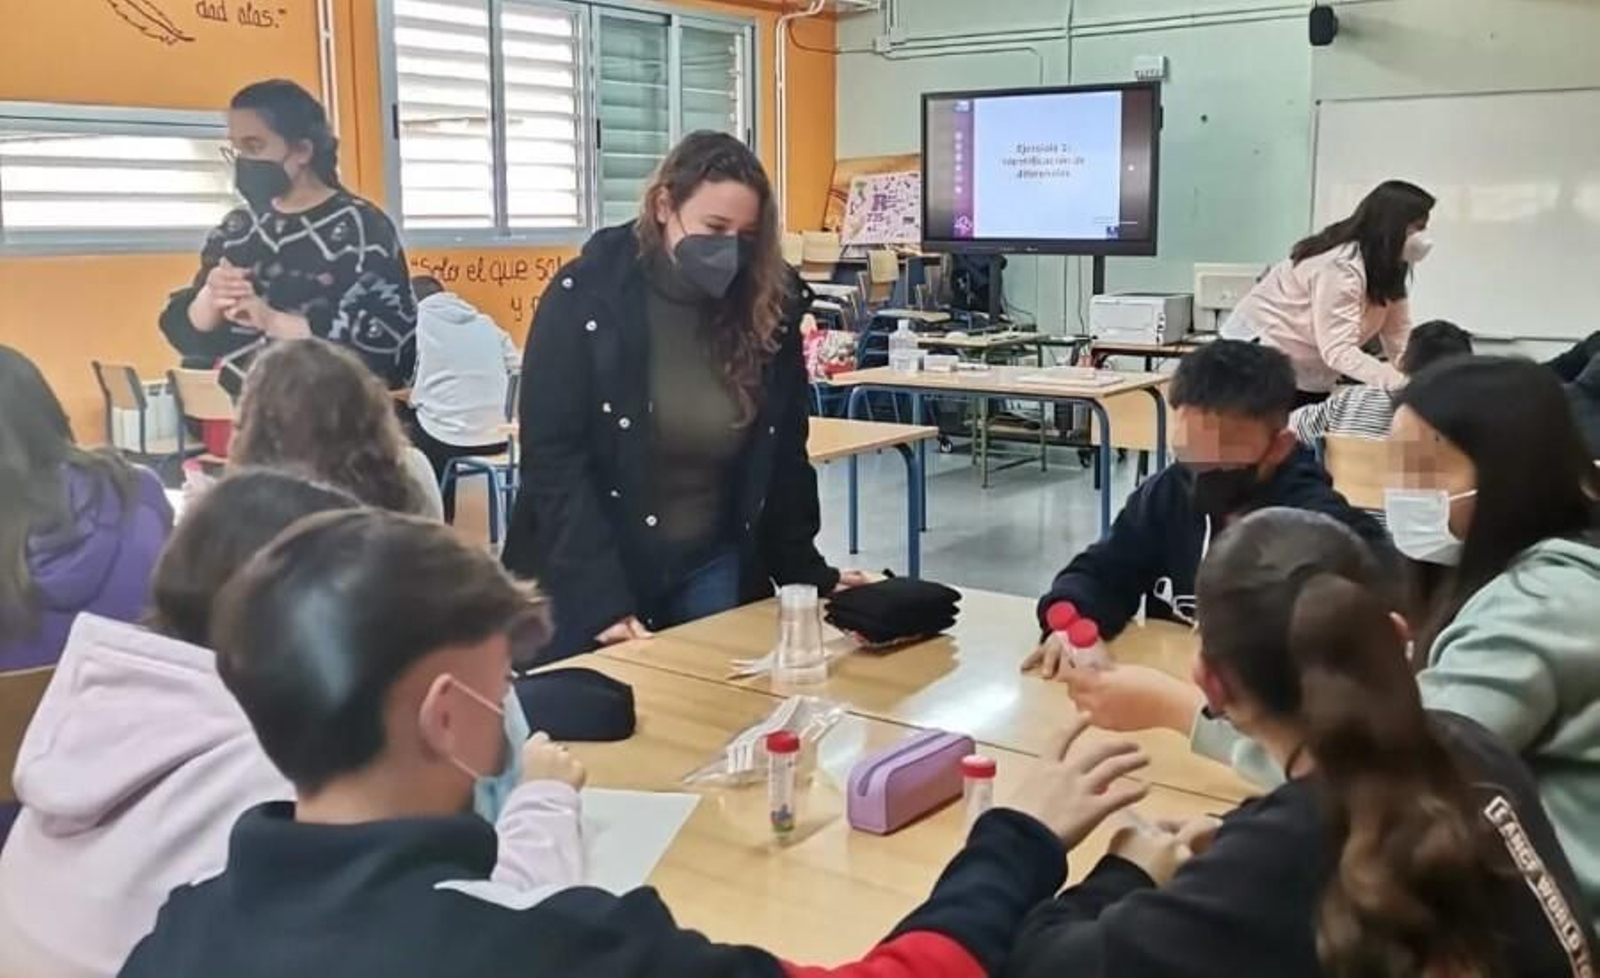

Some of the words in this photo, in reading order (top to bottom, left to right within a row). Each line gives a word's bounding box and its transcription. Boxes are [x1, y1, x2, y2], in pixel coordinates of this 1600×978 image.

[196, 0, 228, 22] dad
[466, 256, 487, 283] el
[490, 260, 528, 286] que
[1536, 873, 1580, 950] WORLD
